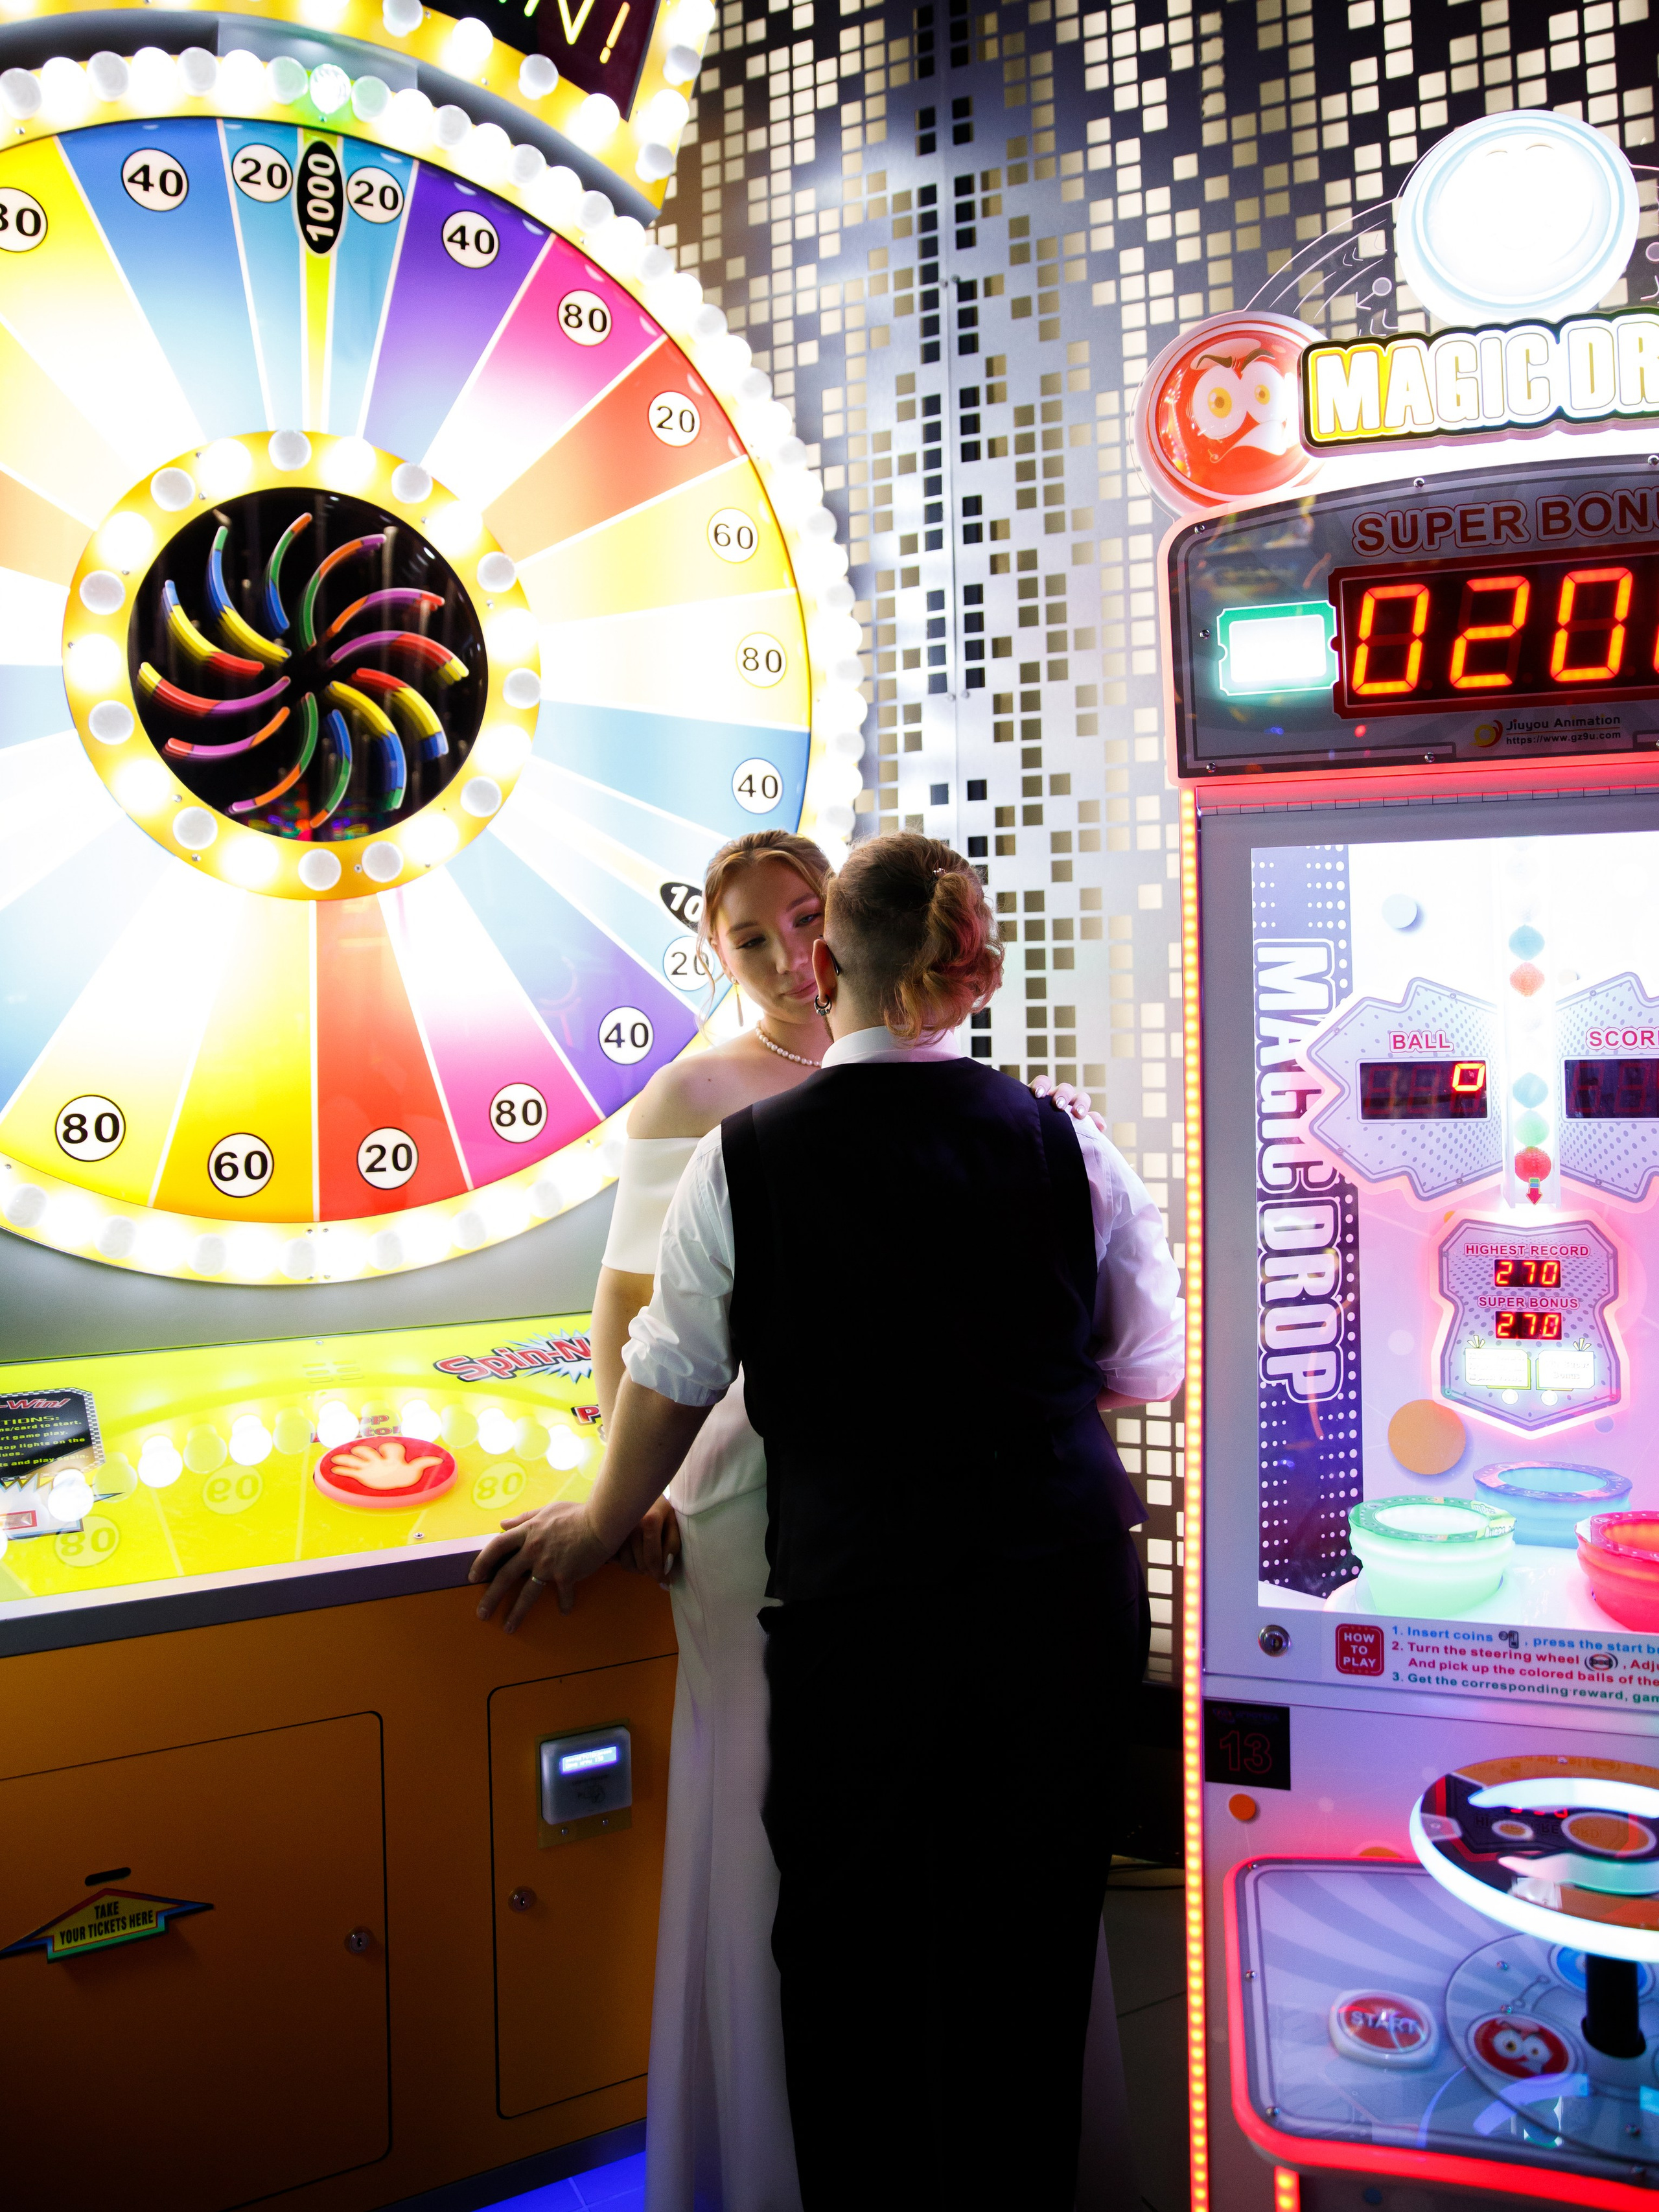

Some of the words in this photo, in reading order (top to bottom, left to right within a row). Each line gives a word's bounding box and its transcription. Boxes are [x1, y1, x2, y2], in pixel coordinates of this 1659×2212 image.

[127, 163, 184, 197] 40
[239, 157, 288, 189] 20
[306, 153, 336, 243] 1000
[353, 180, 400, 212] 20
[447, 225, 495, 255] 40
[563, 304, 608, 333] 80
[1312, 329, 1553, 437] MAGIC
[656, 406, 695, 434] 20
[1356, 506, 1526, 552] SUPER
[1541, 491, 1659, 536] BON
[713, 523, 754, 550] 60
[1351, 567, 1659, 695] 020
[741, 647, 782, 674] 80
[1506, 718, 1549, 731] Jiuyou
[1554, 714, 1621, 728] Animation
[1506, 731, 1621, 745] https://www.gz9u.com
[737, 773, 779, 800] 40
[670, 885, 704, 923] 10
[671, 951, 710, 976] 20
[603, 1021, 649, 1049] 40
[1393, 1034, 1450, 1049] BALL
[1589, 1030, 1659, 1047] SCOR
[495, 1099, 543, 1128] 80
[62, 1112, 120, 1144] 80
[215, 1150, 269, 1182] 60
[365, 1143, 413, 1173] 20
[1466, 1245, 1526, 1255] HIGHEST
[1531, 1246, 1589, 1255] RECORD
[1496, 1261, 1559, 1285] 270
[1262, 1204, 1339, 1397] DROP
[1479, 1296, 1525, 1307] SUPER
[1530, 1298, 1578, 1308] BONUS
[1497, 1313, 1559, 1337] 270
[19, 1441, 50, 1449] lights
[1344, 1632, 1375, 1643] HOW
[1351, 1645, 1368, 1655] TO
[1392, 1625, 1403, 1635] 1.
[1408, 1626, 1449, 1638] Insert
[1454, 1631, 1493, 1642] coins
[1533, 1637, 1575, 1648] press
[1579, 1640, 1603, 1650] the
[1607, 1642, 1642, 1653] start
[1343, 1657, 1376, 1668] PLAY
[1391, 1640, 1404, 1651] 2.
[1408, 1642, 1439, 1653] Turn
[1444, 1645, 1467, 1655] the
[1470, 1647, 1531, 1663] steering
[1536, 1653, 1579, 1664] wheel
[1408, 1658, 1435, 1668] And
[1439, 1660, 1468, 1671] pick
[1472, 1664, 1489, 1674] up
[1493, 1664, 1515, 1675] the
[1519, 1668, 1573, 1680] colored
[1578, 1671, 1614, 1683] balls
[1618, 1675, 1634, 1684] of
[1637, 1676, 1659, 1686] the
[1392, 1671, 1404, 1682] 3.
[1408, 1673, 1432, 1684] Get
[1435, 1675, 1457, 1686] the
[1461, 1679, 1568, 1697] corresponding
[1573, 1687, 1628, 1702] reward,
[1219, 1730, 1273, 1775] 13
[94, 1901, 119, 1920] TAKE
[60, 1926, 86, 1945] YOUR
[88, 1916, 127, 1938] TICKETS
[130, 1910, 154, 1927] HERE
[1351, 2010, 1419, 2035] START
